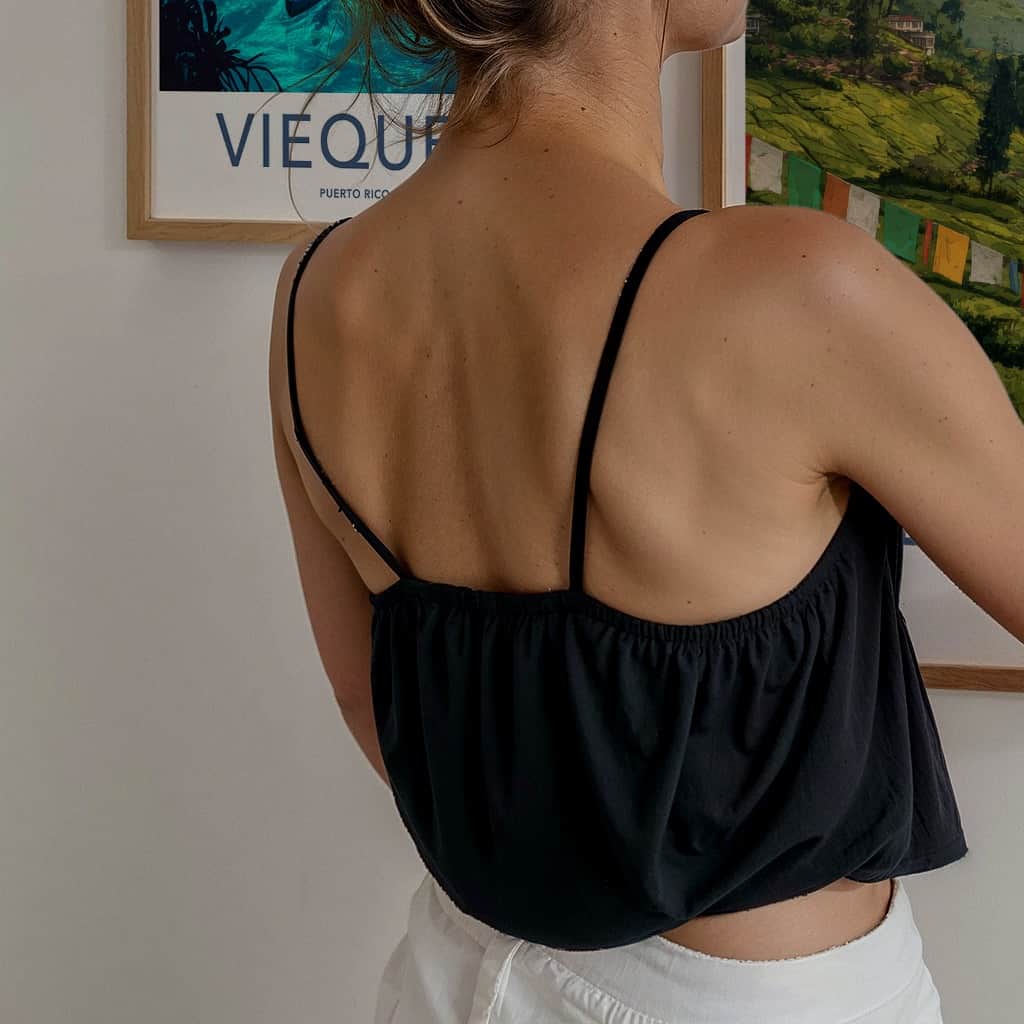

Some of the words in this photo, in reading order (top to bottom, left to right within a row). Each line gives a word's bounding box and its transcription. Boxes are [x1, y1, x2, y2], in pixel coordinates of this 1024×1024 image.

[216, 112, 448, 171] VIEQUE
[319, 188, 361, 199] PUERTO
[364, 189, 390, 200] RICO
